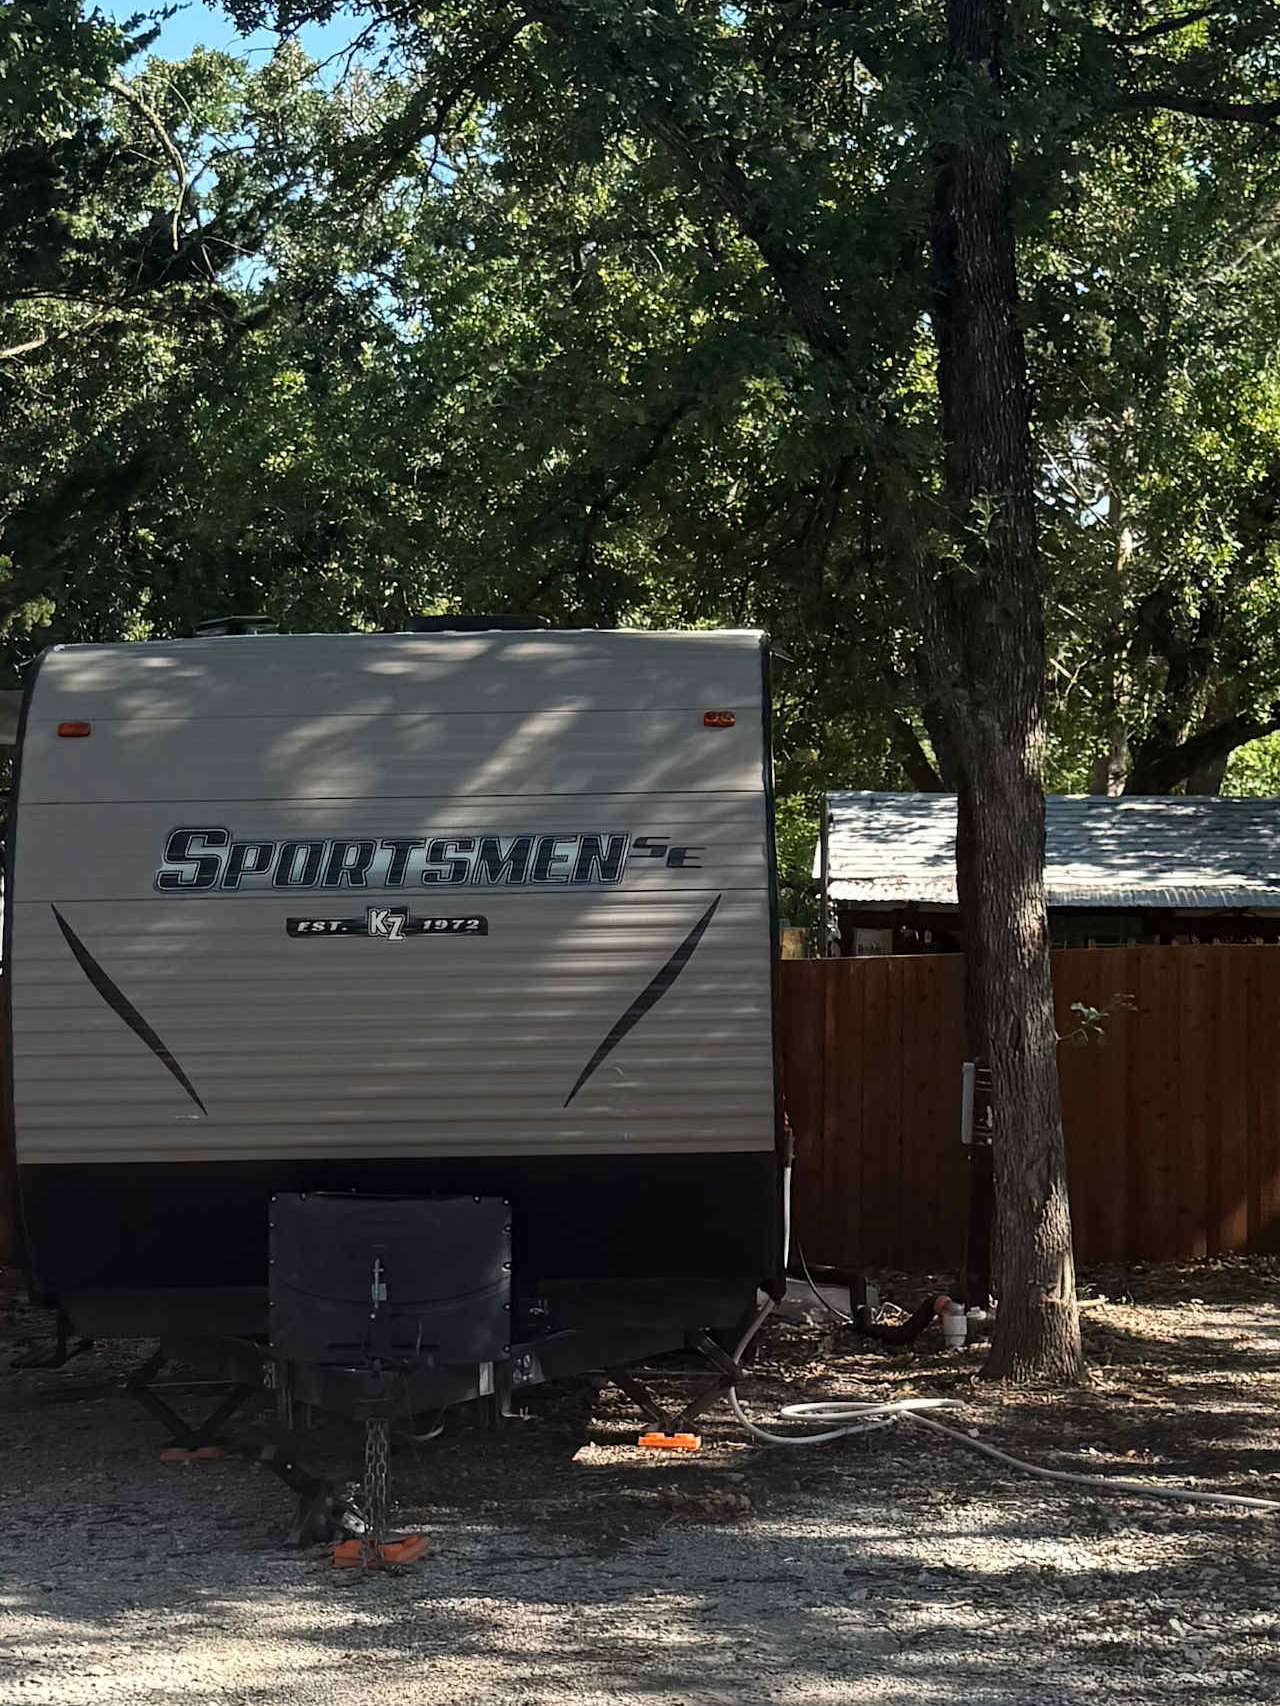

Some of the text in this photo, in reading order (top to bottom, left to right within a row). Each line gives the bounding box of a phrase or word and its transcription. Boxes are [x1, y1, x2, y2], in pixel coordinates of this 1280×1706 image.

[154, 828, 708, 890] SPORTSMEN SE
[296, 908, 481, 942] EST. KZ 1972
